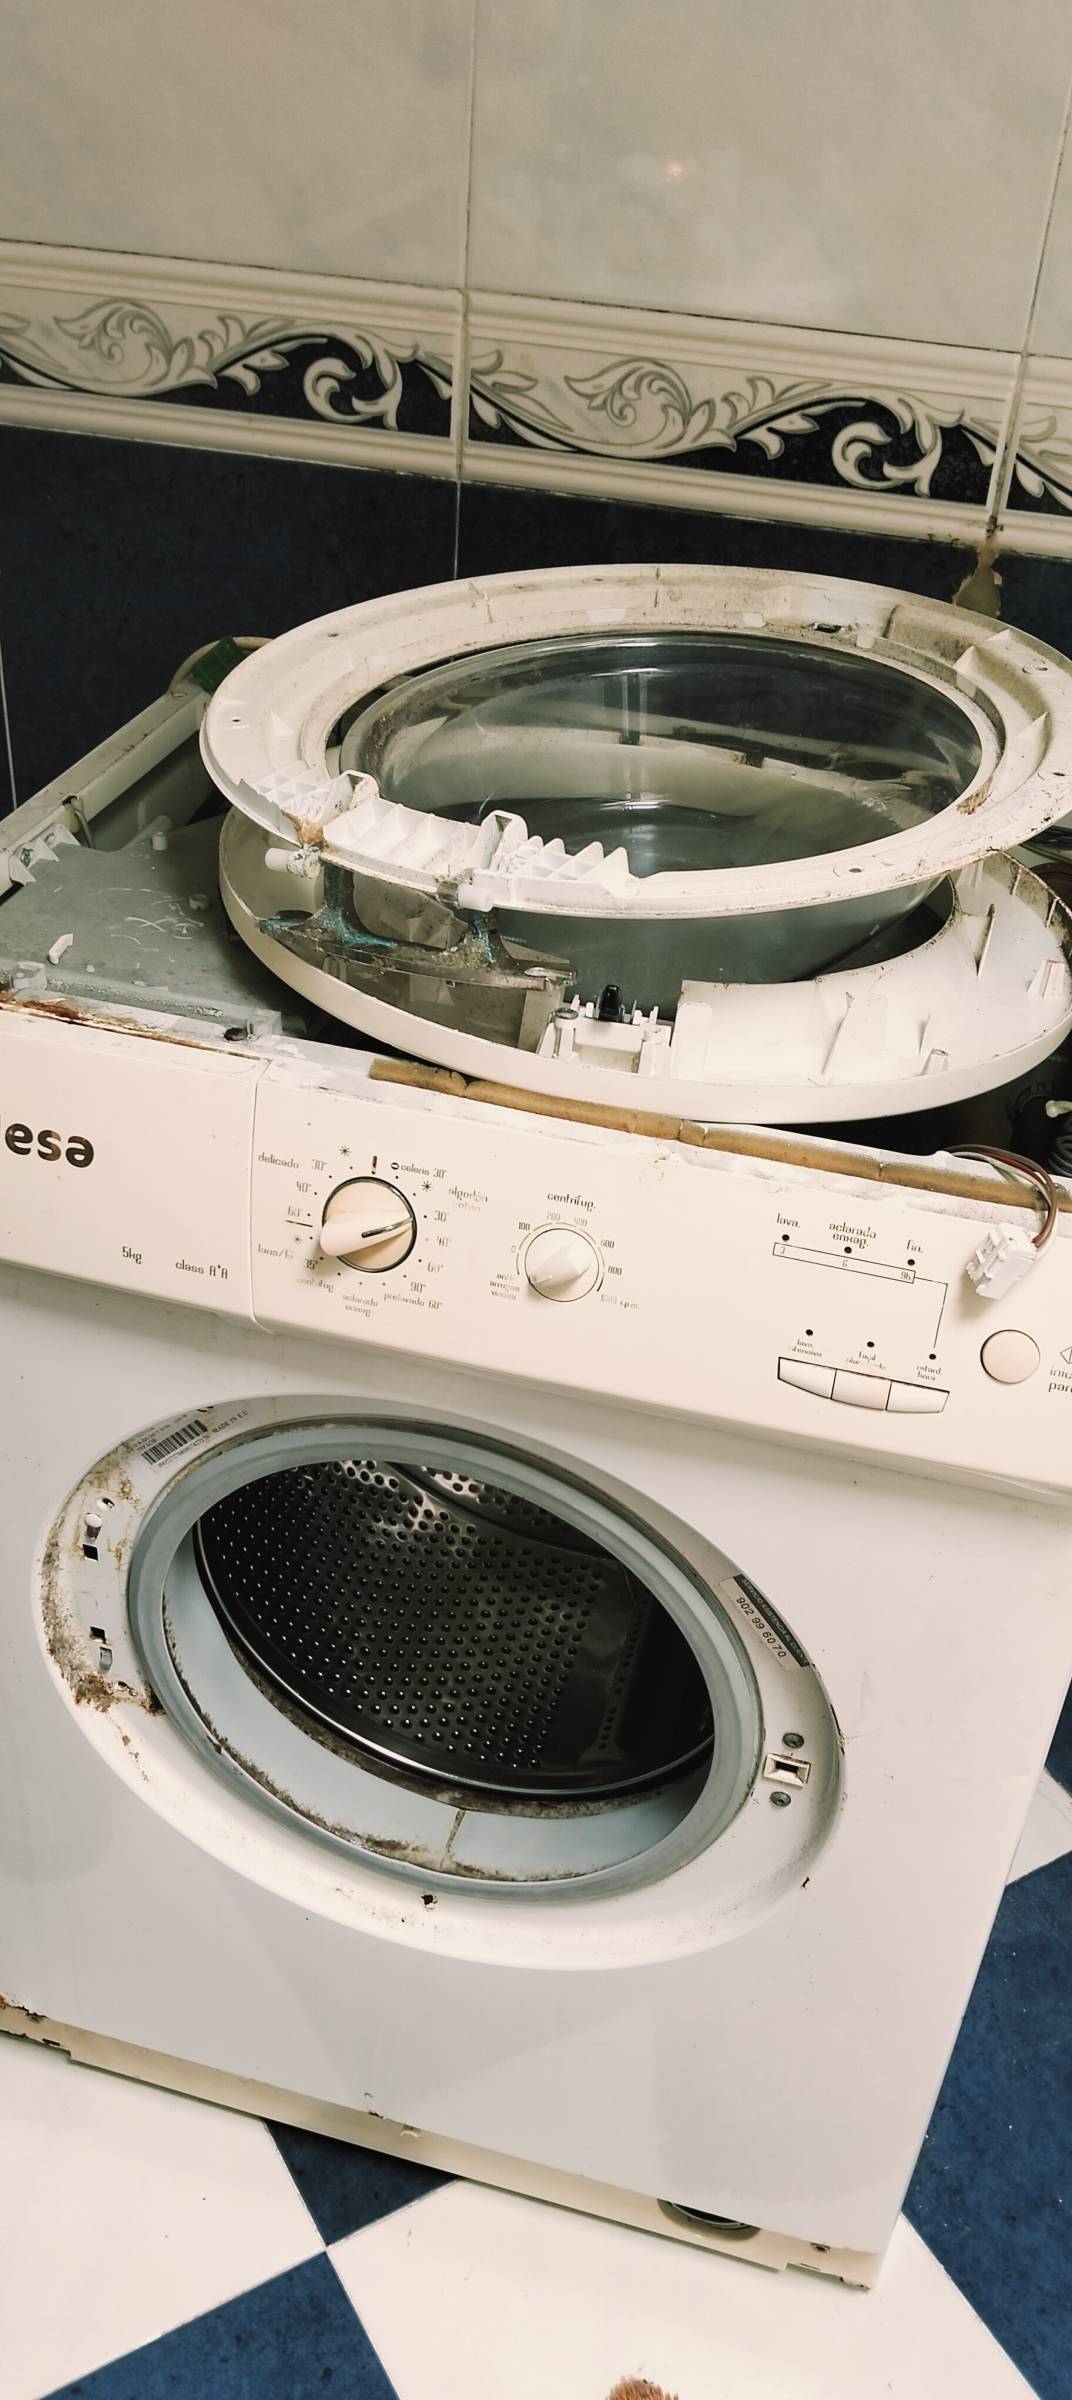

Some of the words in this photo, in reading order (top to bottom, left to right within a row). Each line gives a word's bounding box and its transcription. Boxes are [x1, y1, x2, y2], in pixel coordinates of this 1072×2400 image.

[0, 1115, 95, 1168] esa
[258, 1153, 299, 1170] delicado
[518, 1221, 531, 1232] 100
[829, 1221, 876, 1239] aclarado
[122, 1246, 142, 1265] 5kg
[736, 1597, 754, 1616] 902
[751, 1617, 766, 1630] 99
[762, 1632, 776, 1644] 60
[772, 1644, 787, 1658] 70
